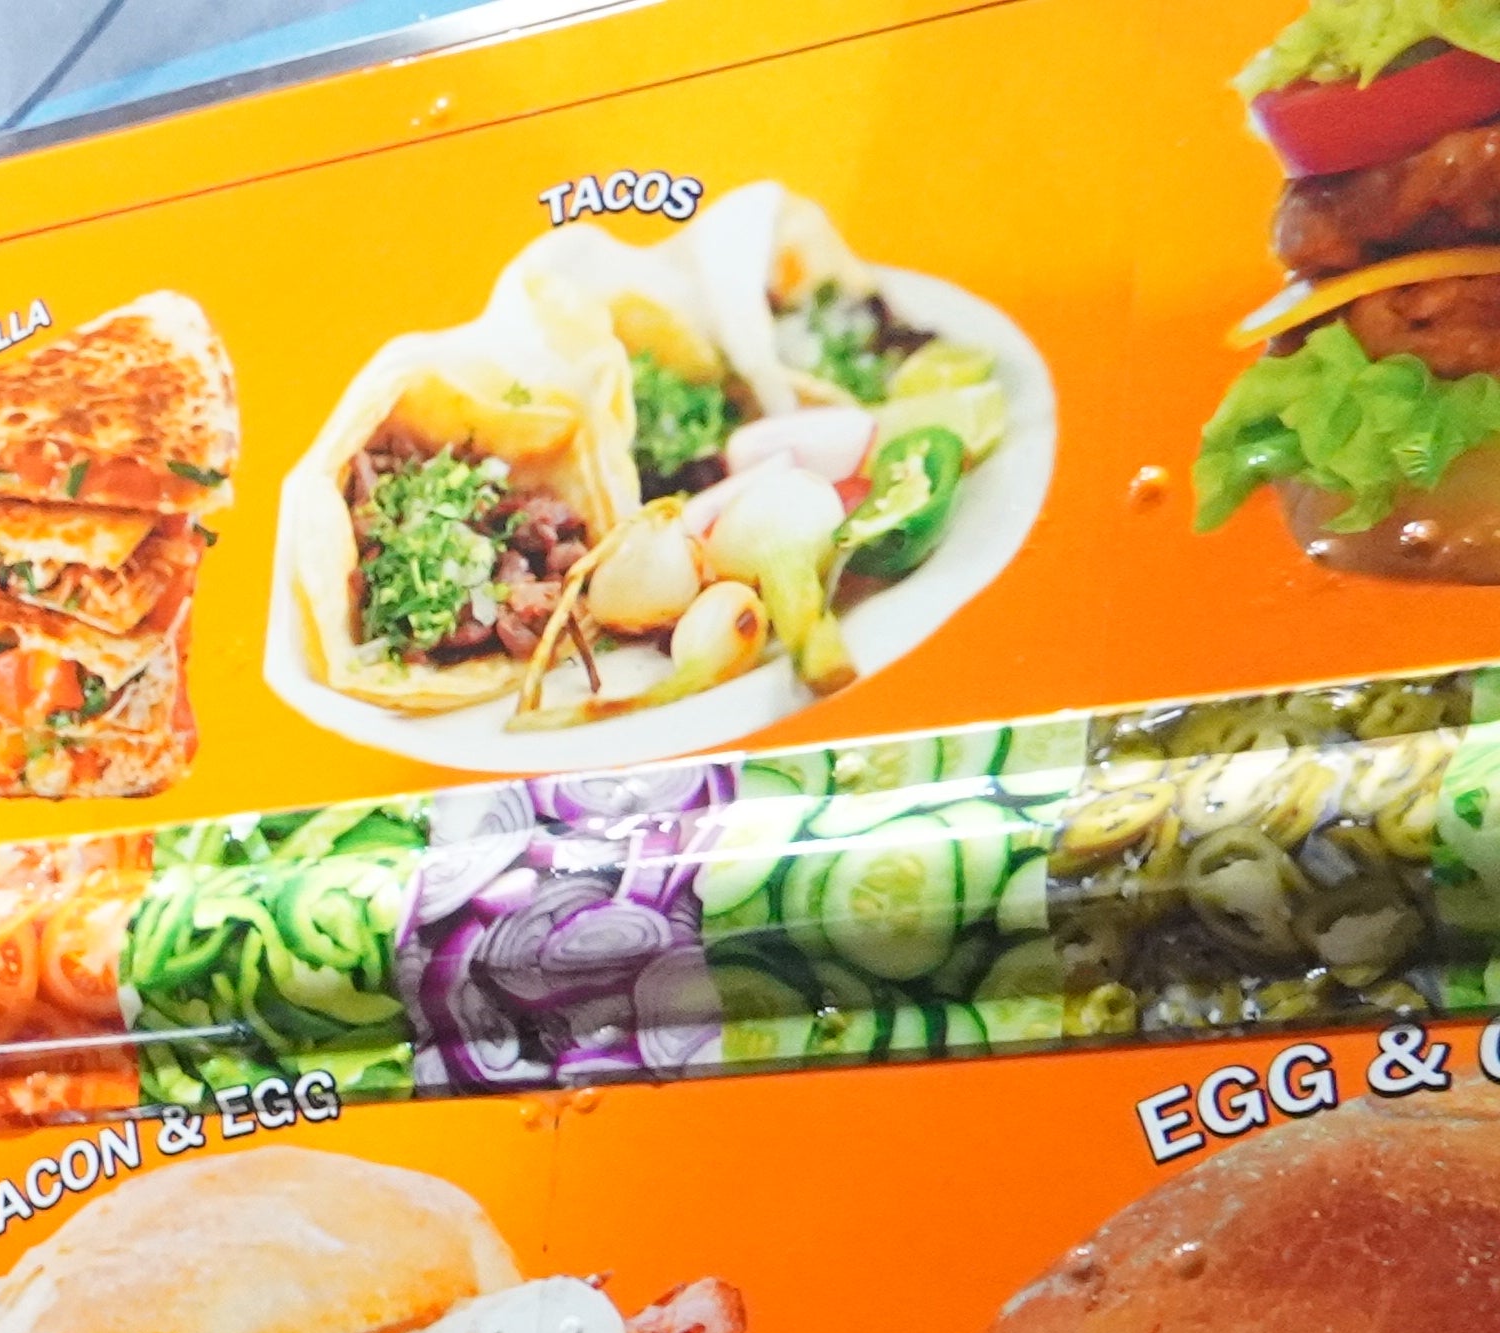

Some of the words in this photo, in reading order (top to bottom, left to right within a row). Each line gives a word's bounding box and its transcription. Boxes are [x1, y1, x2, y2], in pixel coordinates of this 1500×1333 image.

[539, 170, 704, 228] TACOS
[155, 1105, 205, 1157] &
[216, 1069, 341, 1142] EGG
[1137, 1043, 1338, 1165] EGG
[1366, 1021, 1451, 1098] &
